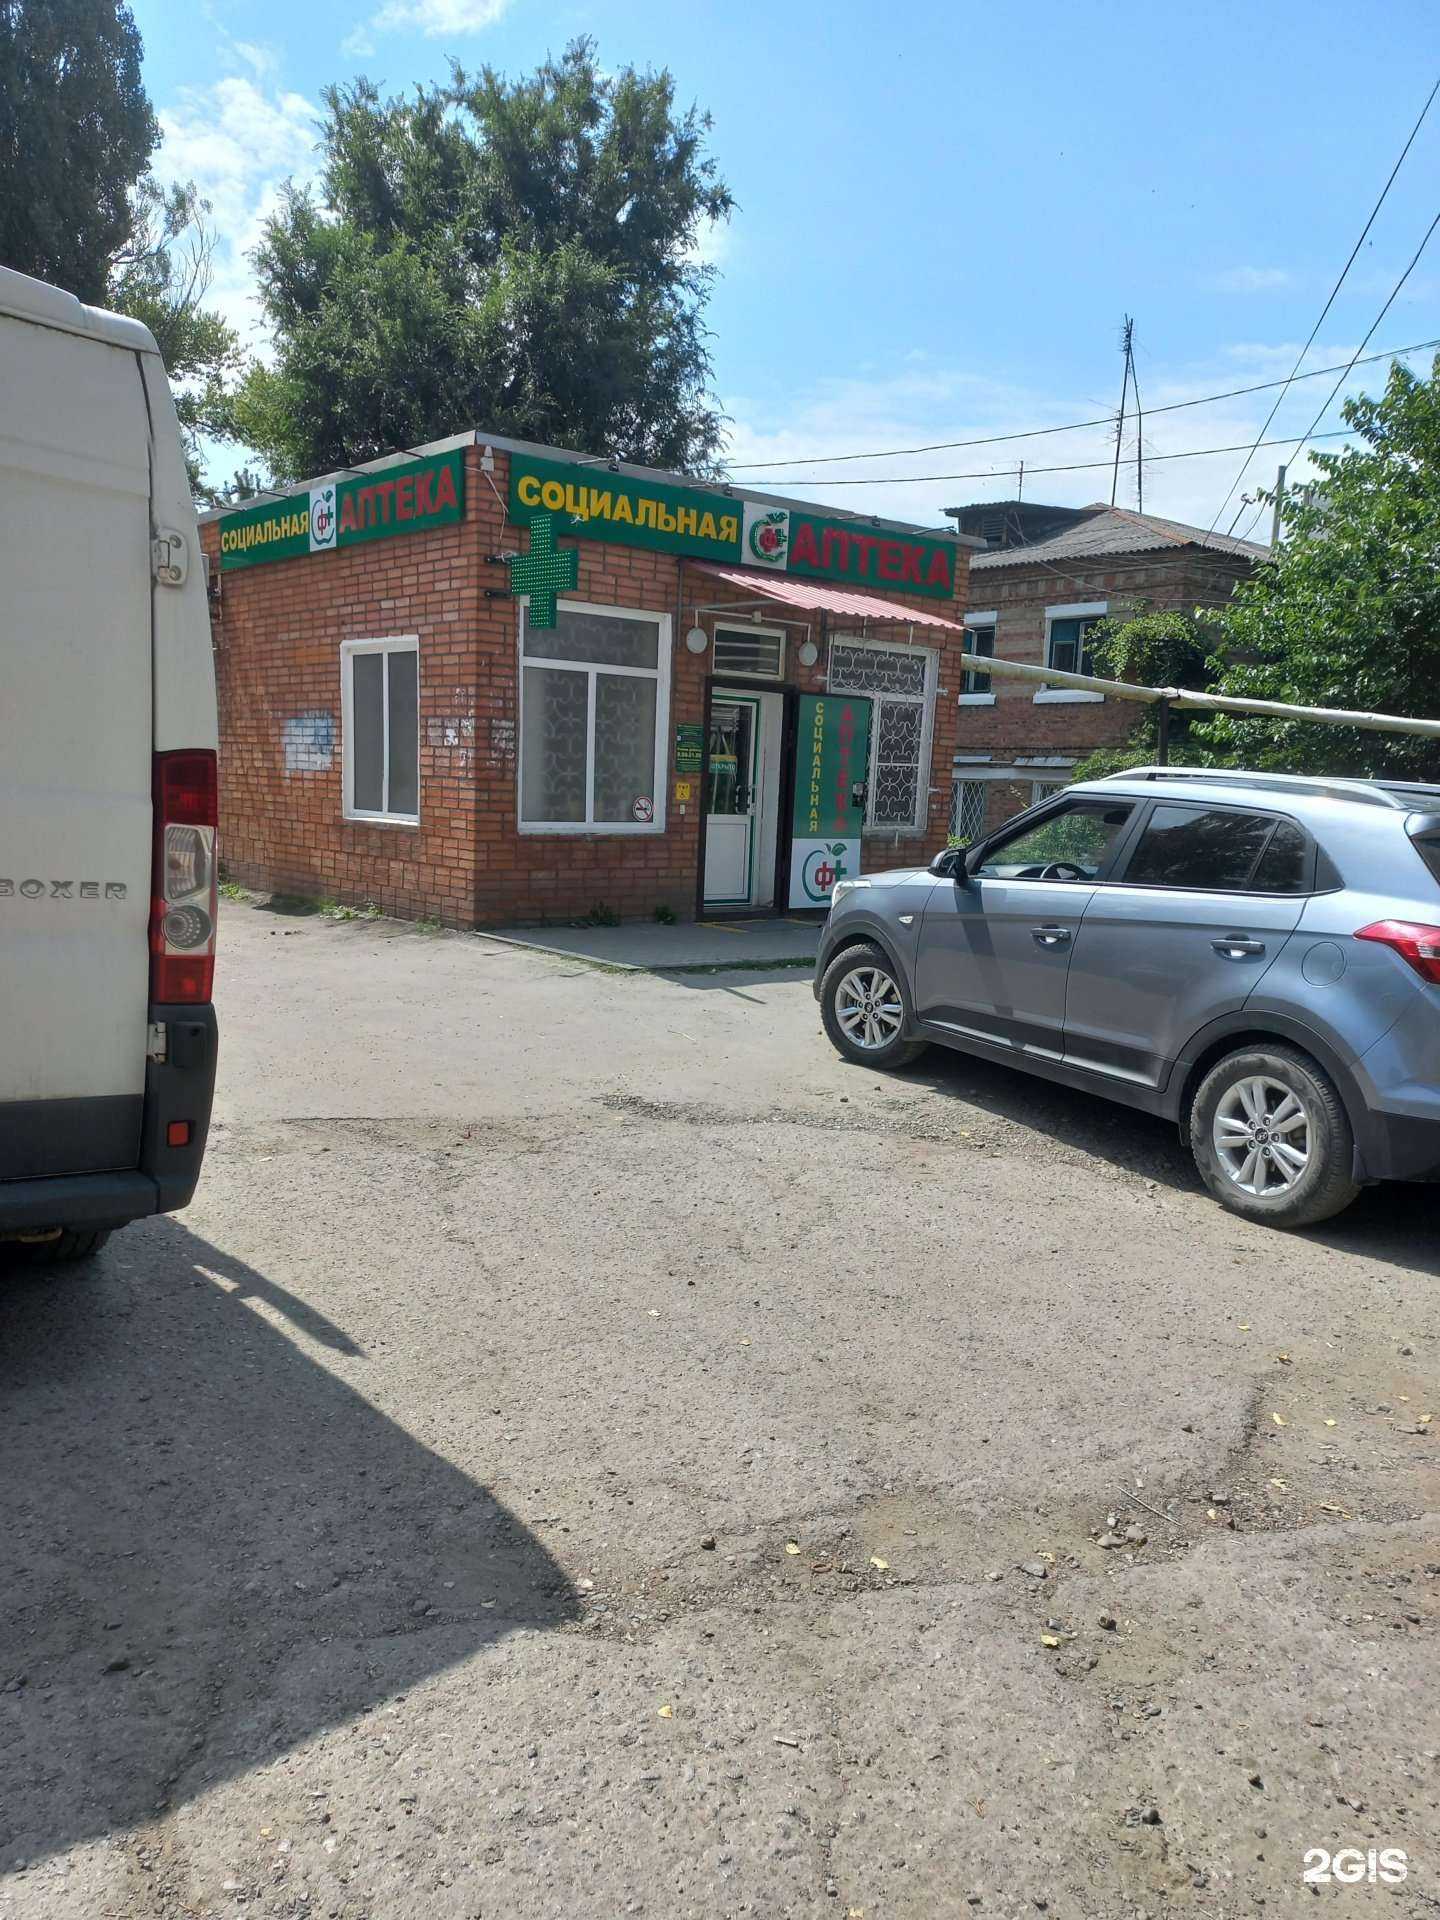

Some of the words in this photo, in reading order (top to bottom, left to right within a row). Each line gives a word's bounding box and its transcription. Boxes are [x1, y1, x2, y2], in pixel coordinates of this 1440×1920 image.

[221, 510, 309, 553] СОЦИАЛЬНАЯ
[338, 464, 457, 534] АПТЕКА
[517, 475, 738, 543] СОЦИАЛЬНАЯ
[791, 523, 950, 588] АПТЕКА
[809, 702, 824, 832] СОЦИАЛЬНАЯ
[832, 704, 854, 833] АПТЕКА
